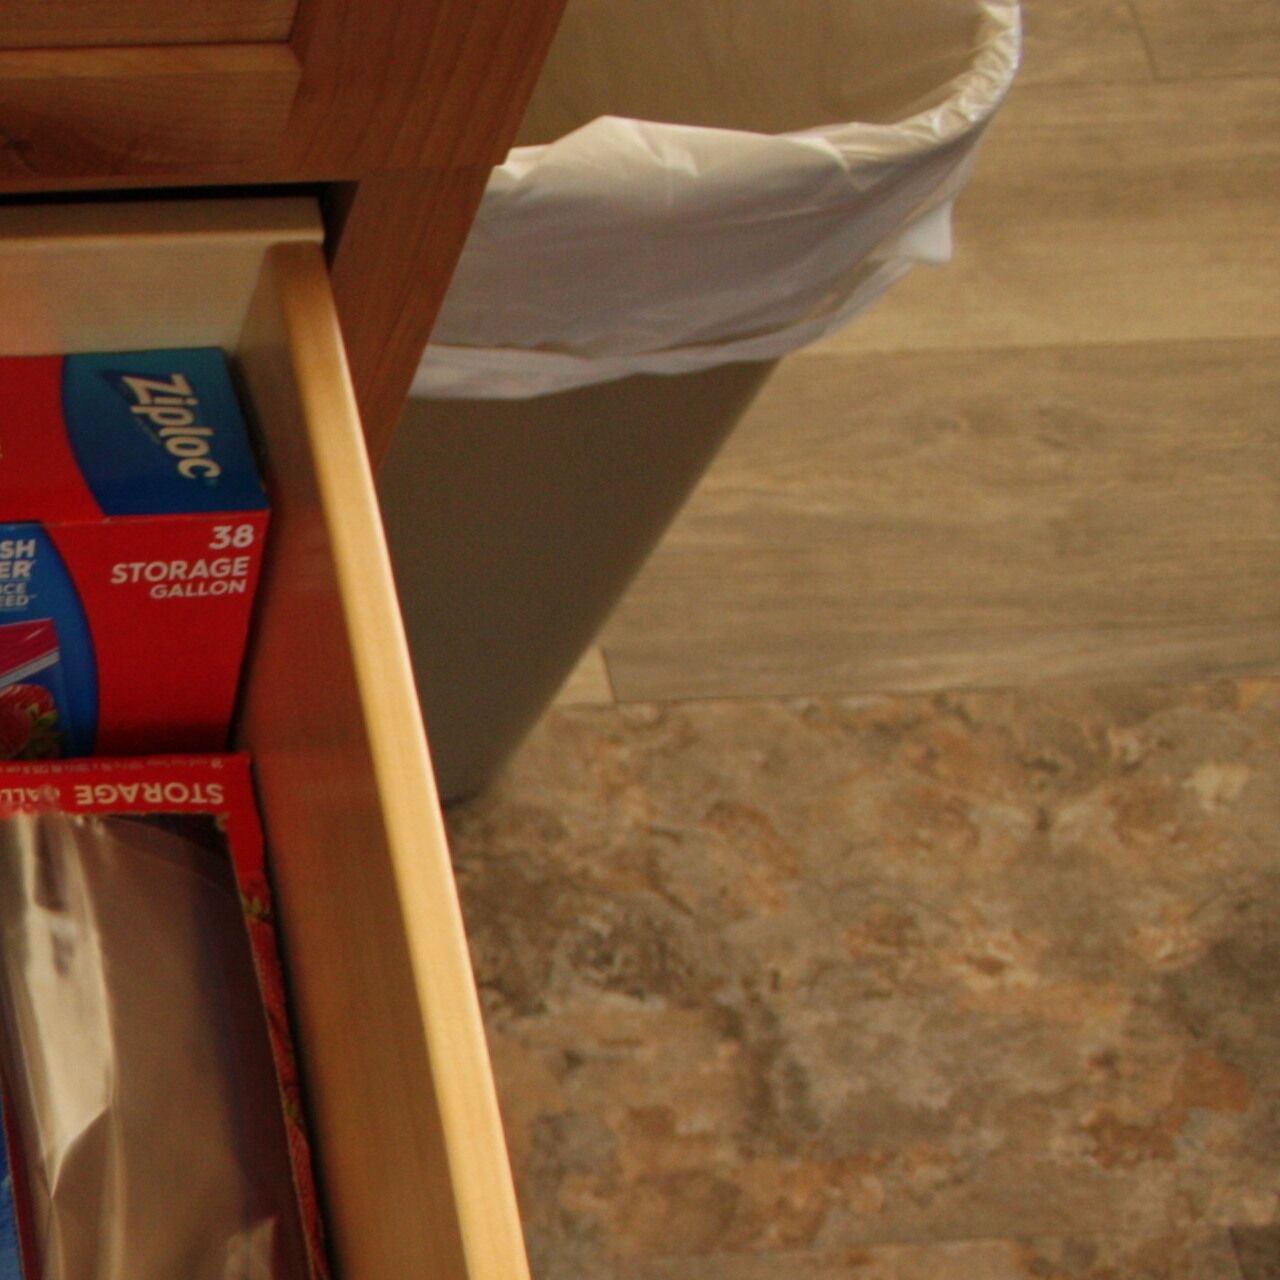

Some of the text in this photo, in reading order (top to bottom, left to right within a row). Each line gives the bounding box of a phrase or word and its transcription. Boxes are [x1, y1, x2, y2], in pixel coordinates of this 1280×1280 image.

[122, 373, 222, 480] Ziploc
[208, 523, 254, 550] 38
[109, 556, 251, 585] STORAGE
[148, 579, 247, 600] GALLON
[74, 782, 225, 806] STORAGE
